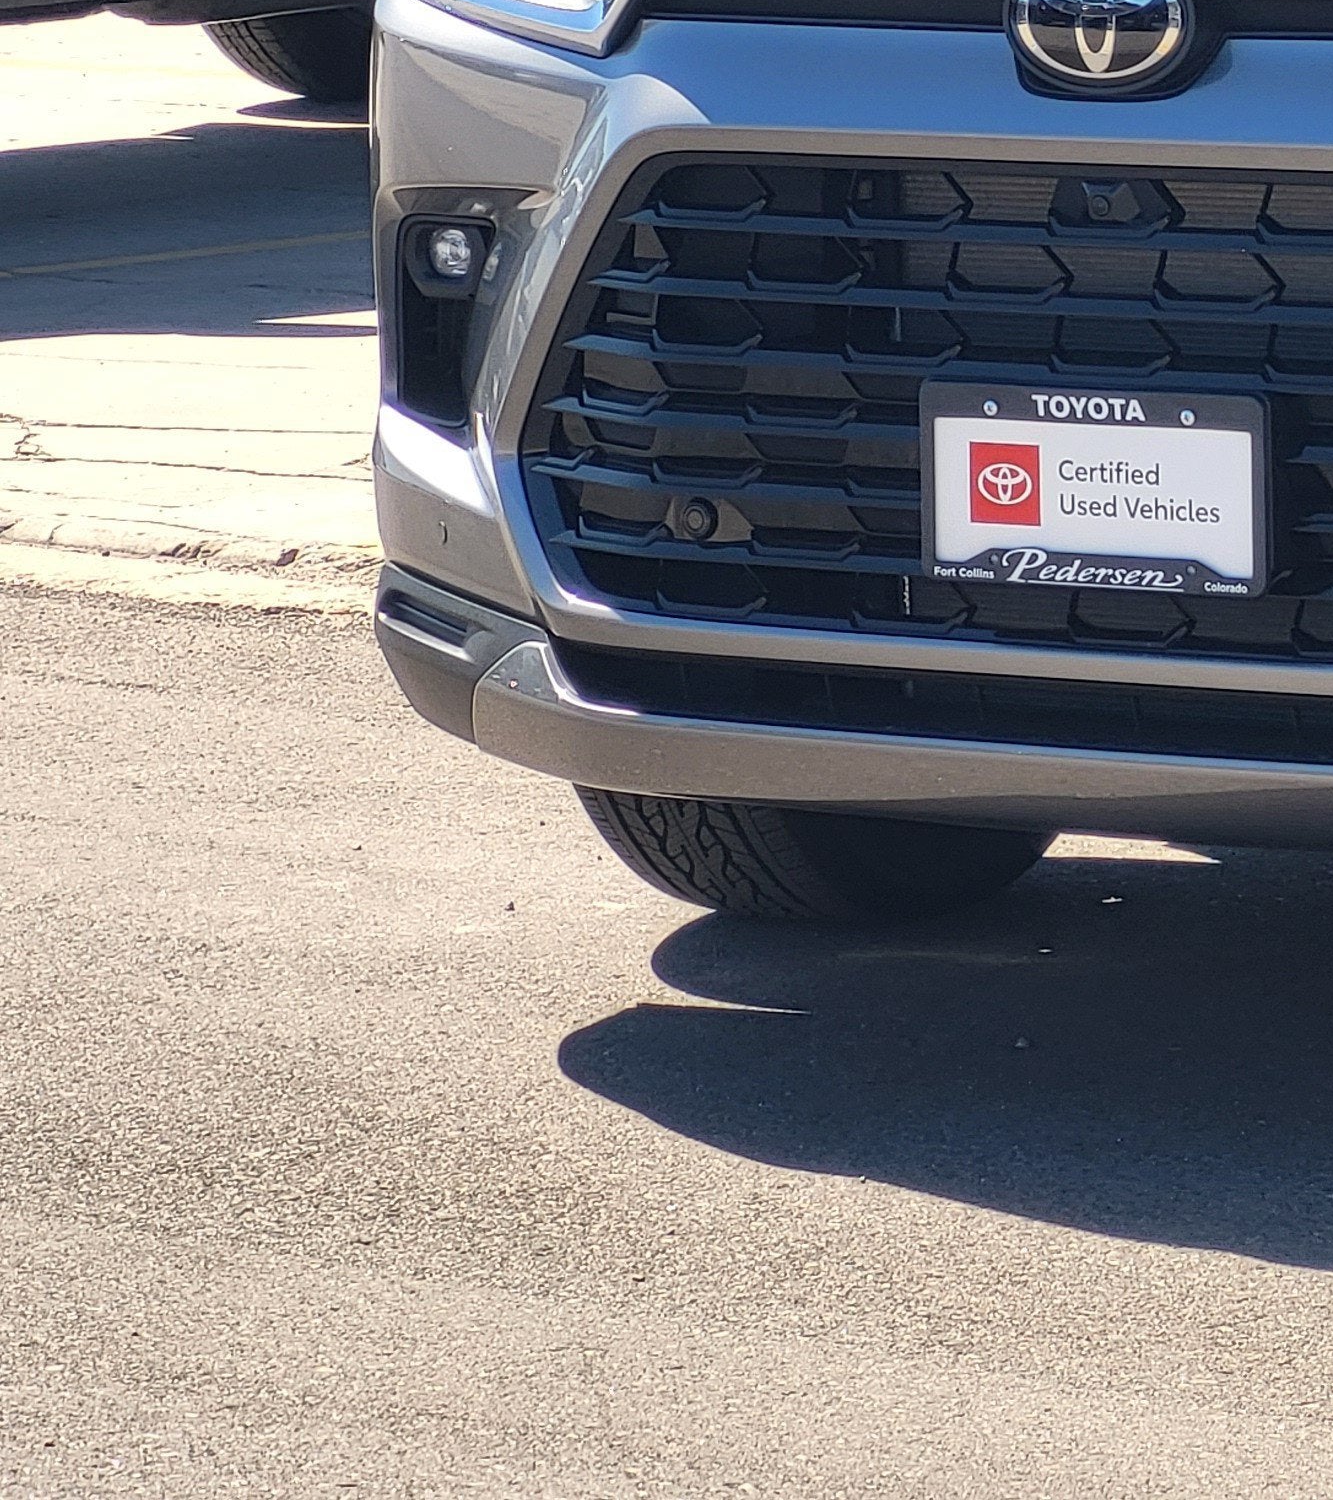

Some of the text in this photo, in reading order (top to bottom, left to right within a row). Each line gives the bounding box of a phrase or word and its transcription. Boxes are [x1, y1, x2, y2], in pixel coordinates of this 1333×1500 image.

[1031, 394, 1146, 422] TOYOTA
[1058, 459, 1160, 486] Certified
[1059, 493, 1221, 523] Used Vehicles
[933, 565, 995, 579] Fort Collins
[1001, 548, 1184, 588] Pedersen
[1204, 581, 1249, 594] Colorado
